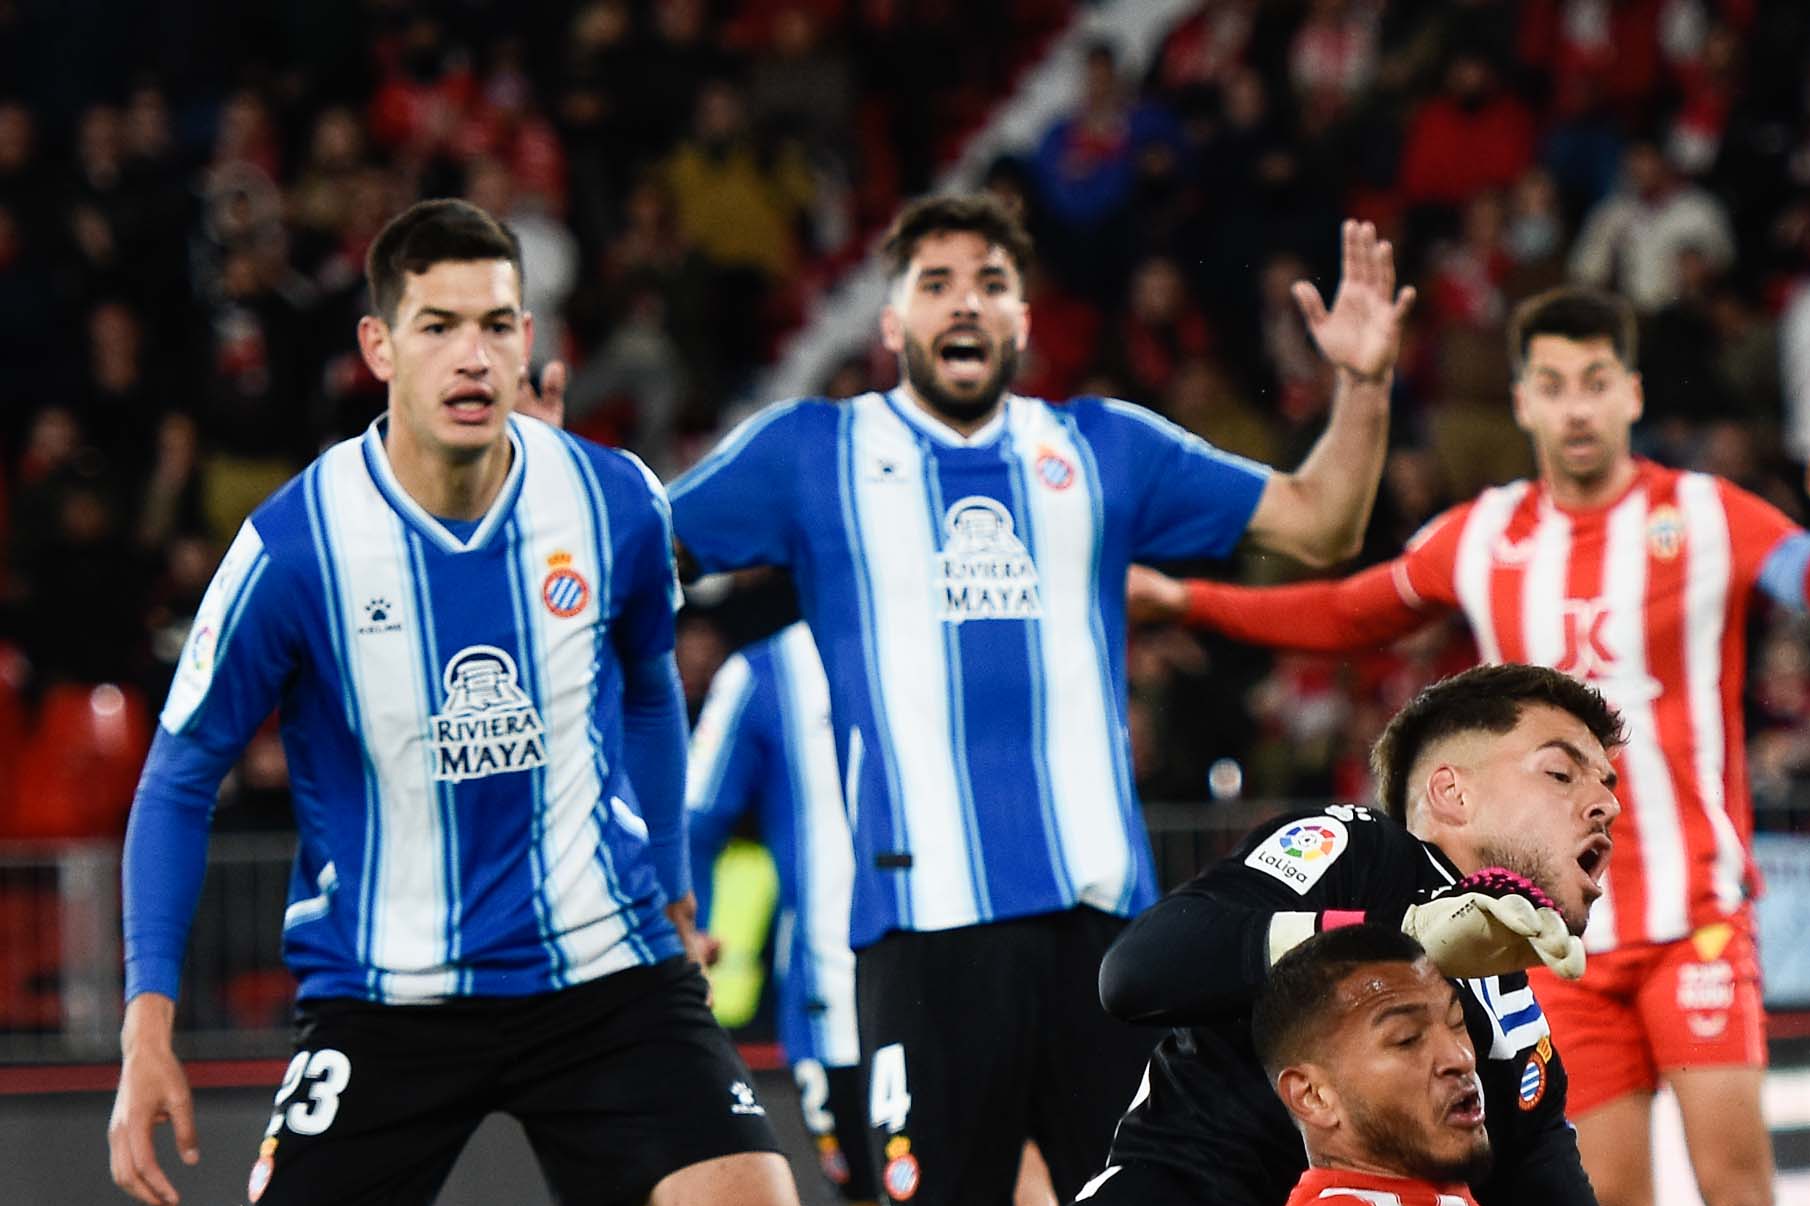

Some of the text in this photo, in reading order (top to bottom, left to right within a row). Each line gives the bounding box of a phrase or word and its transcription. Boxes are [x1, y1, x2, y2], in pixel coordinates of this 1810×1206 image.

[944, 586, 1036, 614] MAYA
[437, 713, 538, 743] RIVIERA
[439, 739, 542, 775] MAYA
[1257, 850, 1308, 883] LaLiga
[264, 1048, 352, 1136] 23
[869, 1042, 912, 1134] 4
